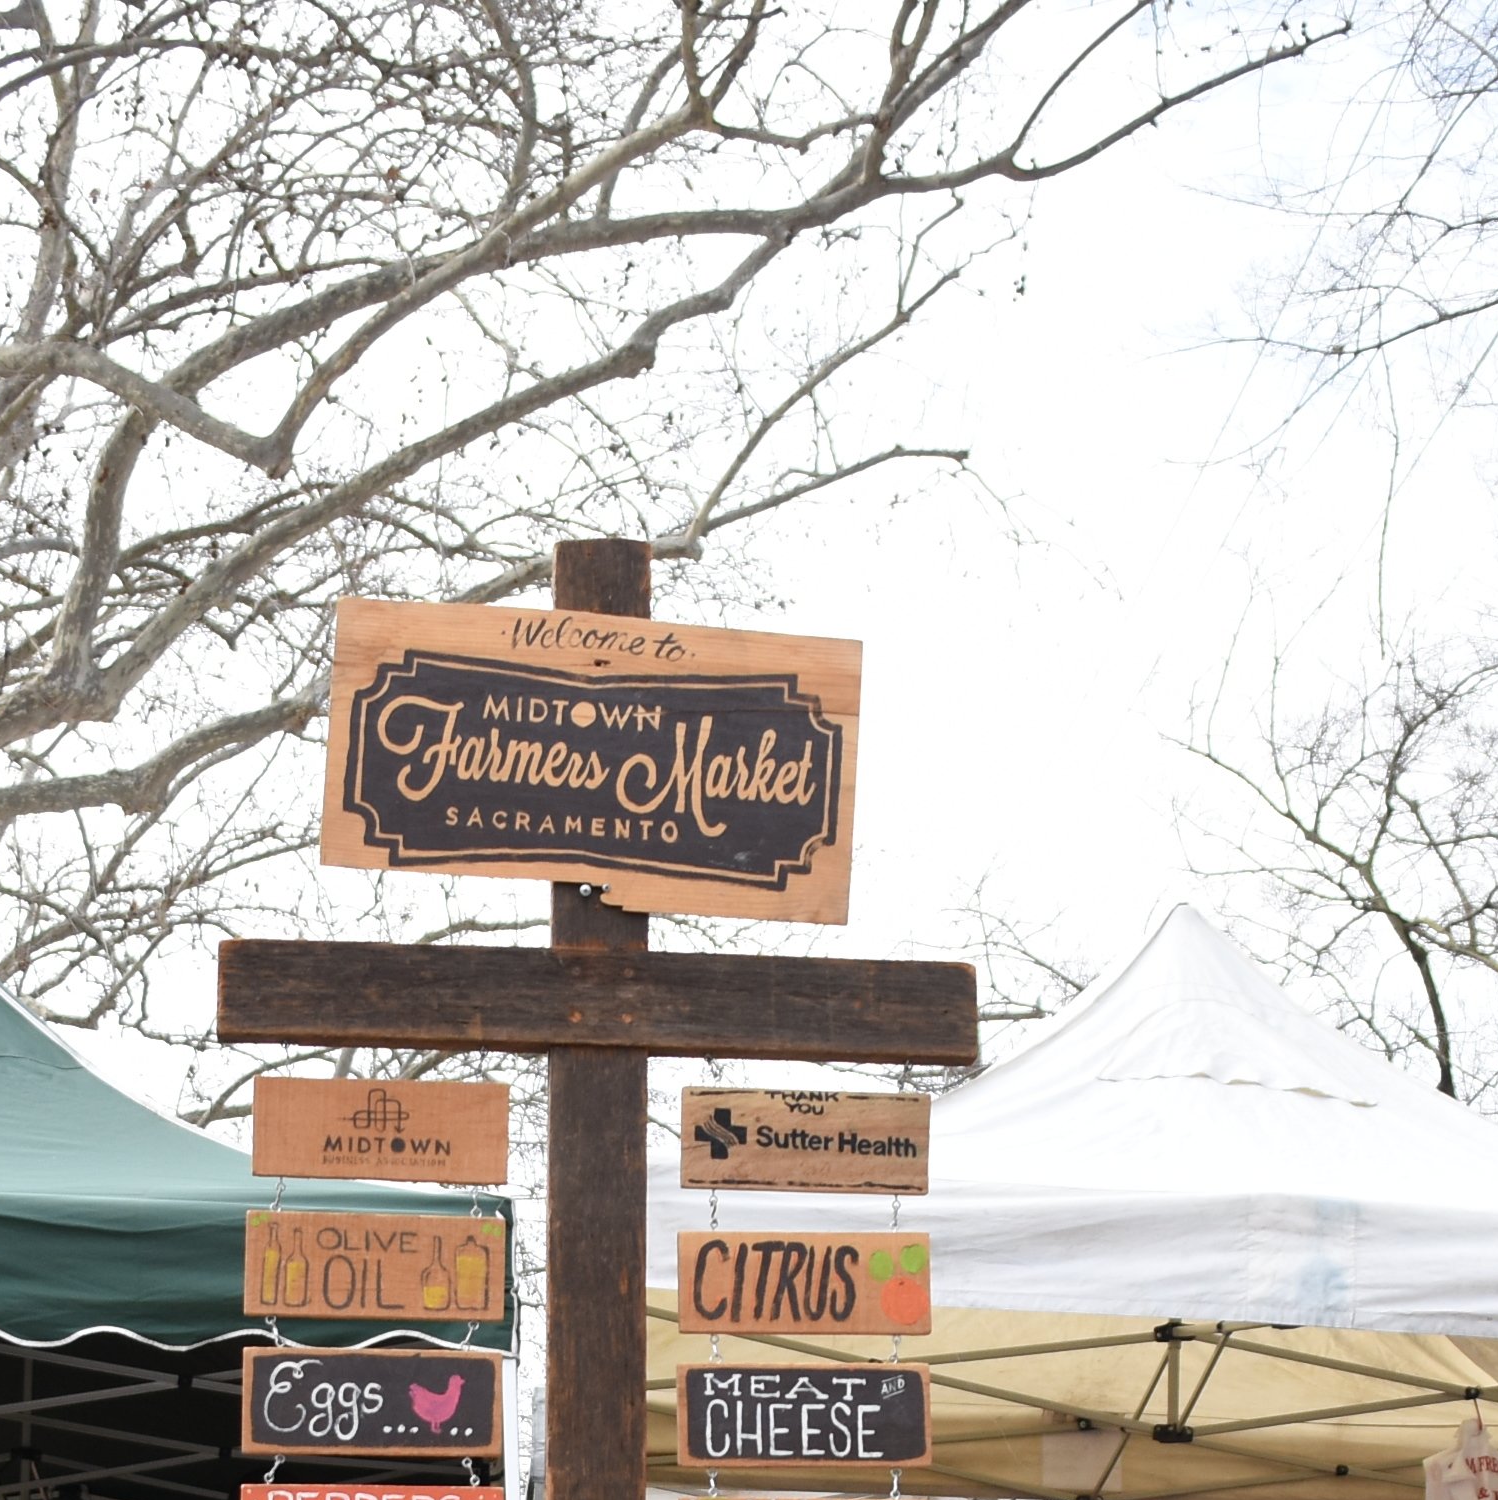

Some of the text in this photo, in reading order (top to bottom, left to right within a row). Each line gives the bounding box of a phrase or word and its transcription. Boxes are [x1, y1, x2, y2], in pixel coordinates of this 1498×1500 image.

[510, 617, 686, 661] Welcome to
[481, 694, 662, 732] MIDTOWN
[376, 694, 816, 838] Farmers Market
[445, 806, 679, 843] SACRAMENTO
[764, 1090, 839, 1103] THANK
[784, 1102, 825, 1116] YOU
[323, 1134, 452, 1157] MIDTOWN
[755, 1125, 918, 1159] Sutter Health
[322, 1155, 447, 1167] BUSINESS ASSOCIATION
[316, 1227, 418, 1252] OLIVE
[323, 1254, 406, 1310] OIL
[693, 1238, 860, 1322] CITRUS
[704, 1372, 906, 1400] MEAT AND
[704, 1398, 884, 1459] CHEESE
